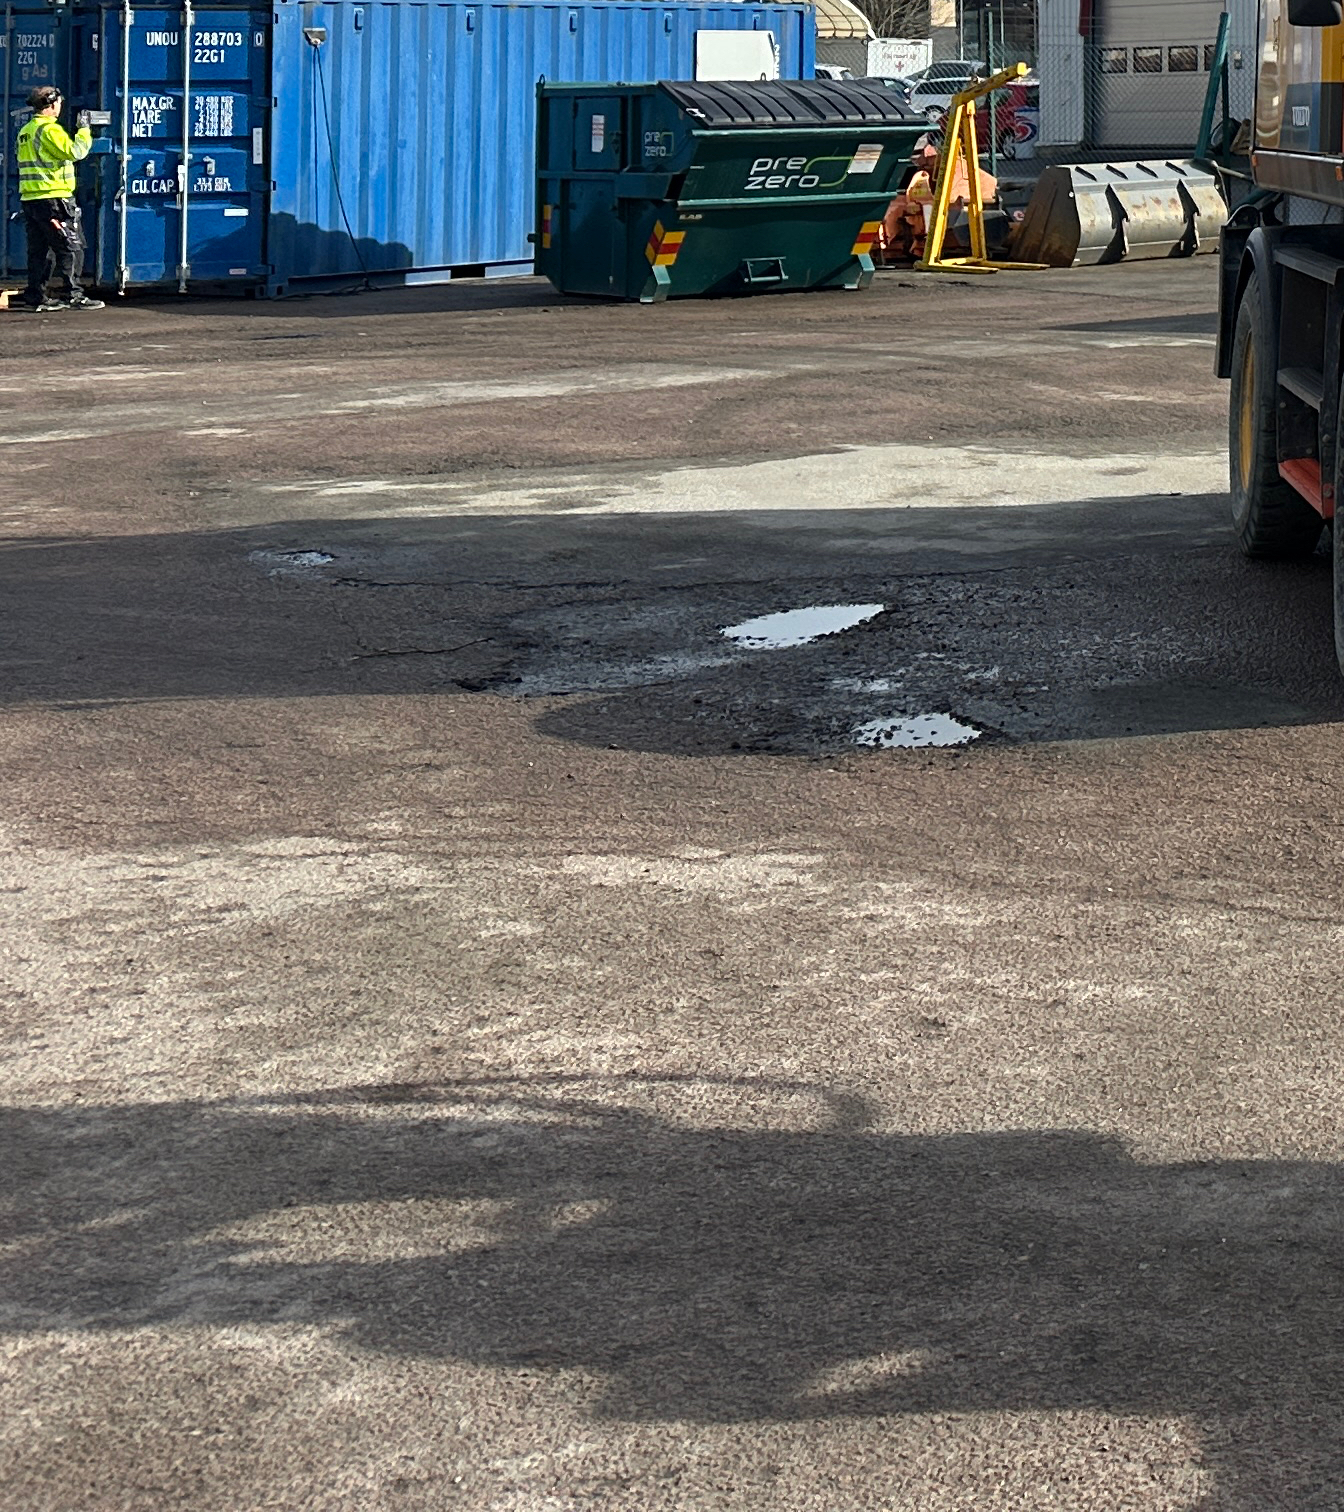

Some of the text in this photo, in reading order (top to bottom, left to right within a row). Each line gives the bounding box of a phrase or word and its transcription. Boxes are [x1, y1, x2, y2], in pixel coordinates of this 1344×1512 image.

[146, 31, 178, 46] UNOU
[194, 31, 242, 46] 288703
[132, 109, 162, 124] TARE
[131, 123, 154, 138] NET
[644, 131, 661, 144] pre
[644, 145, 667, 157] zero
[749, 156, 808, 176] pre
[743, 174, 820, 191] zero
